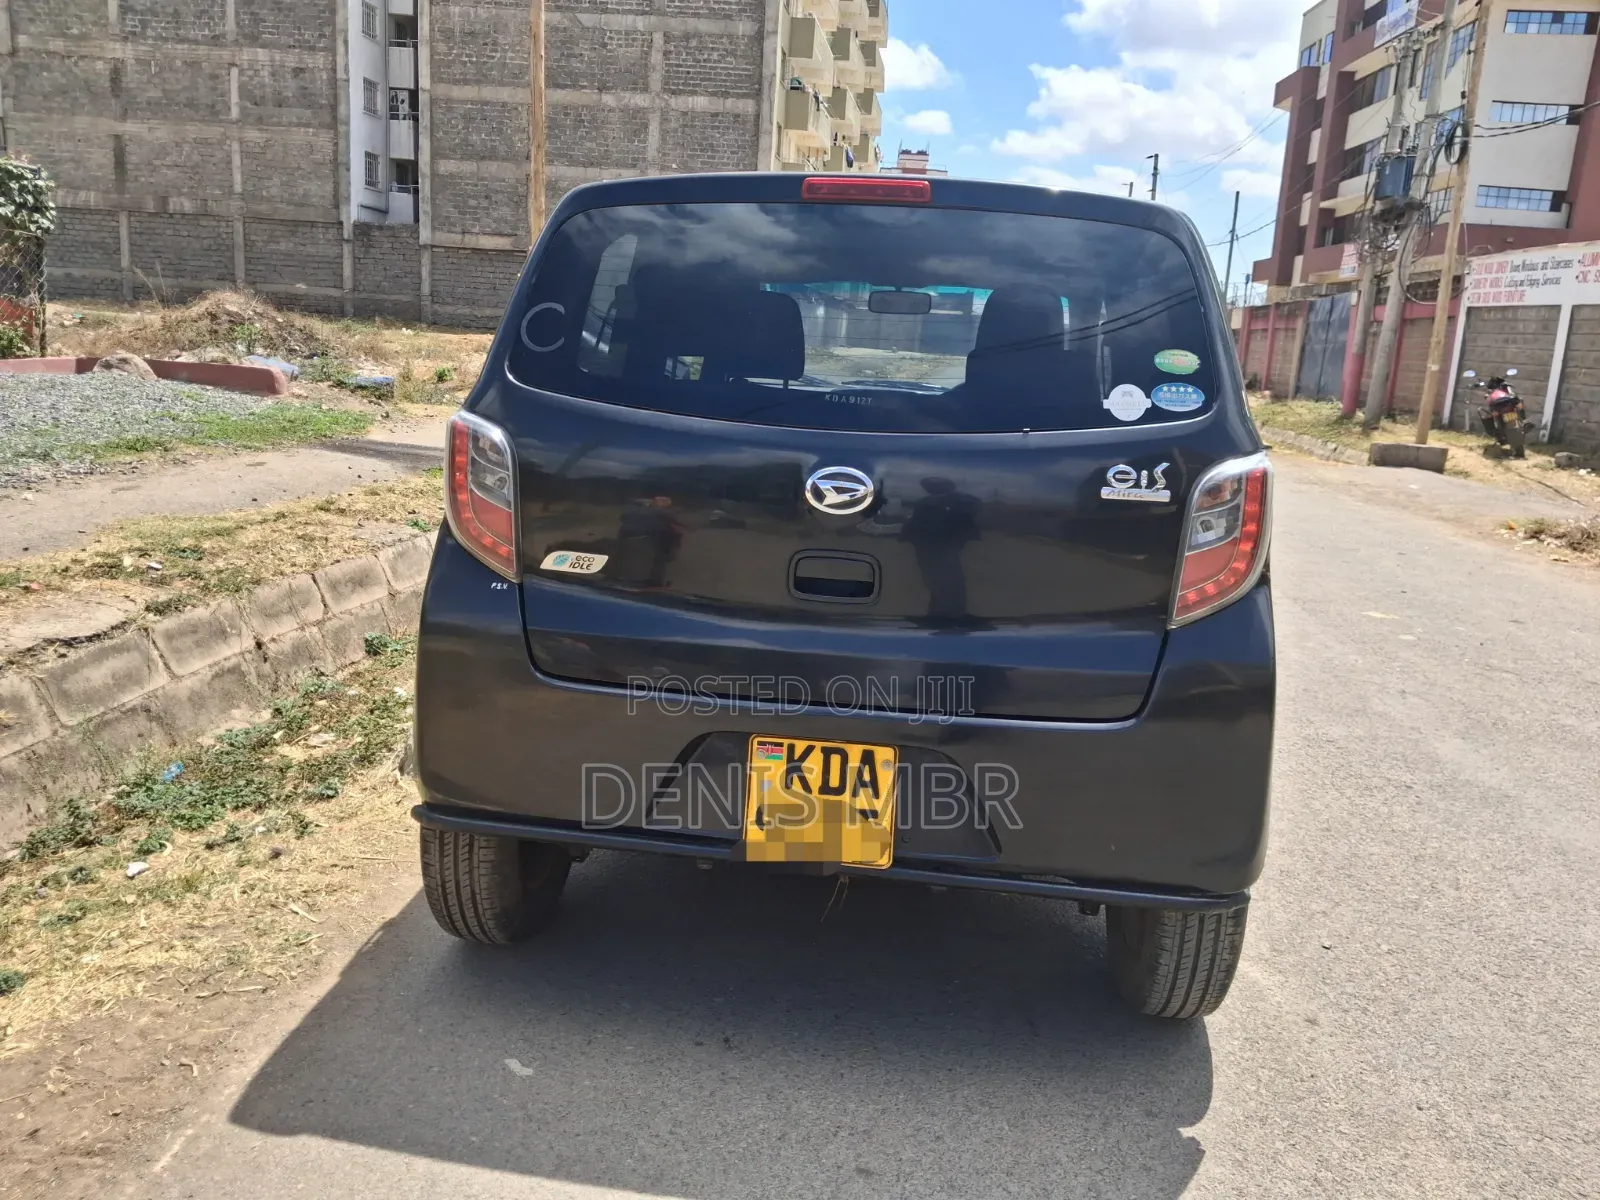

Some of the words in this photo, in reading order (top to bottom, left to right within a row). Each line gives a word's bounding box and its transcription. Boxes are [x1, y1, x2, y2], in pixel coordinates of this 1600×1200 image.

[575, 555, 595, 563] eco
[568, 562, 593, 571] IDLE
[785, 743, 880, 800] KDA
